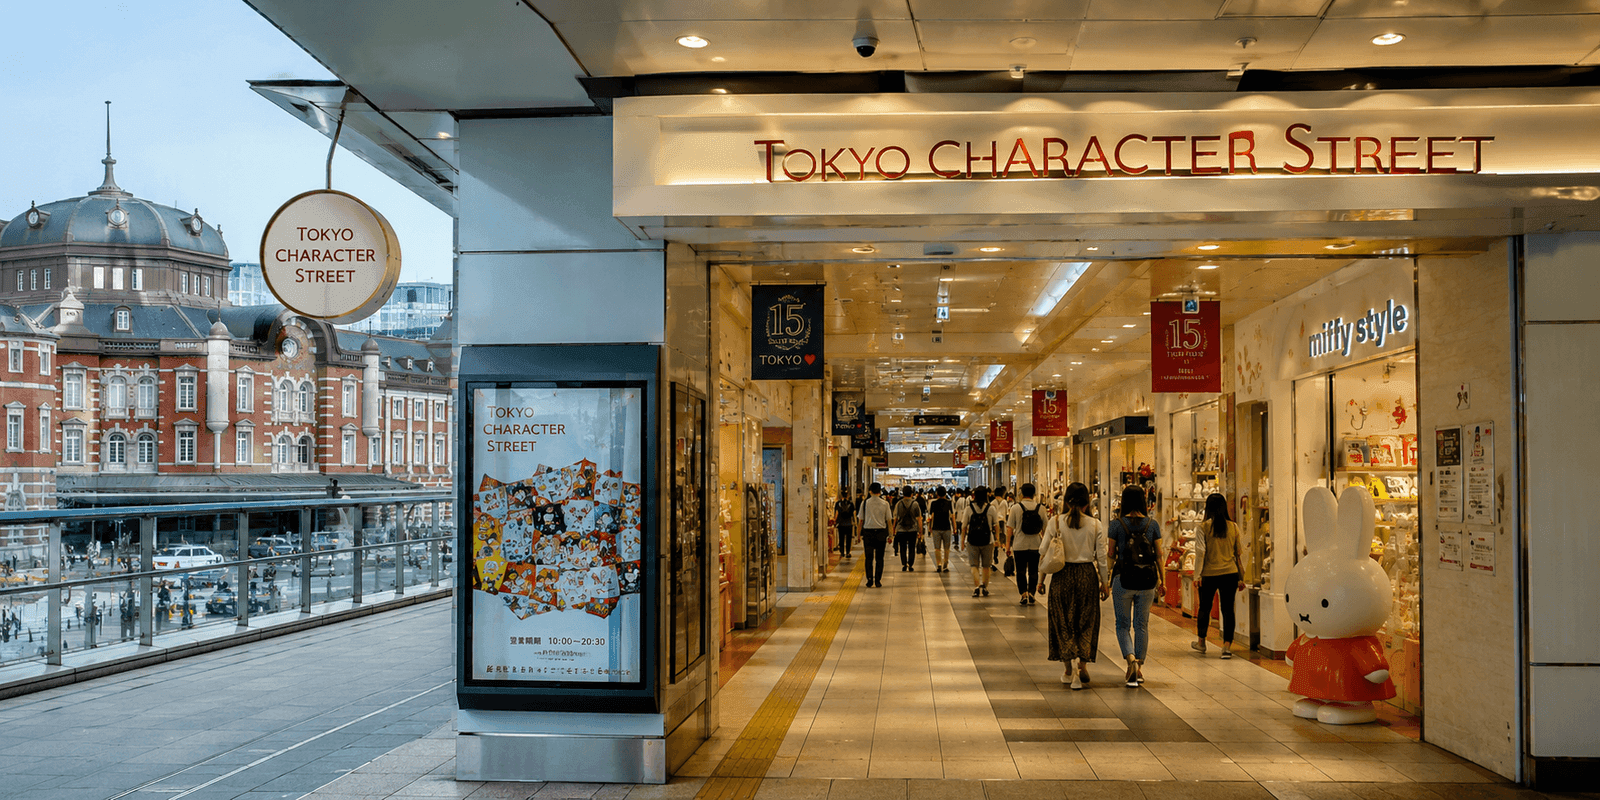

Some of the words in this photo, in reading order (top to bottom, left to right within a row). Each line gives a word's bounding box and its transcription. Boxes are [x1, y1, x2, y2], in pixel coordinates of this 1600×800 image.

[754, 140, 911, 183] TOKYO
[928, 130, 1258, 179] CHARACTER
[1283, 123, 1495, 175] STREET
[296, 226, 354, 241] TOKYO
[275, 248, 376, 262] CHARACTER
[295, 268, 356, 283] STREET
[769, 303, 807, 336] 15
[1168, 319, 1202, 350] 15
[1309, 317, 1354, 357] miffy
[1356, 298, 1409, 347] style
[759, 355, 802, 366] TOKYO
[487, 405, 535, 418] TOKYO
[840, 399, 857, 416] 15
[1041, 398, 1058, 415] 15
[483, 424, 566, 435] CHARACTER
[487, 440, 537, 452] STREET
